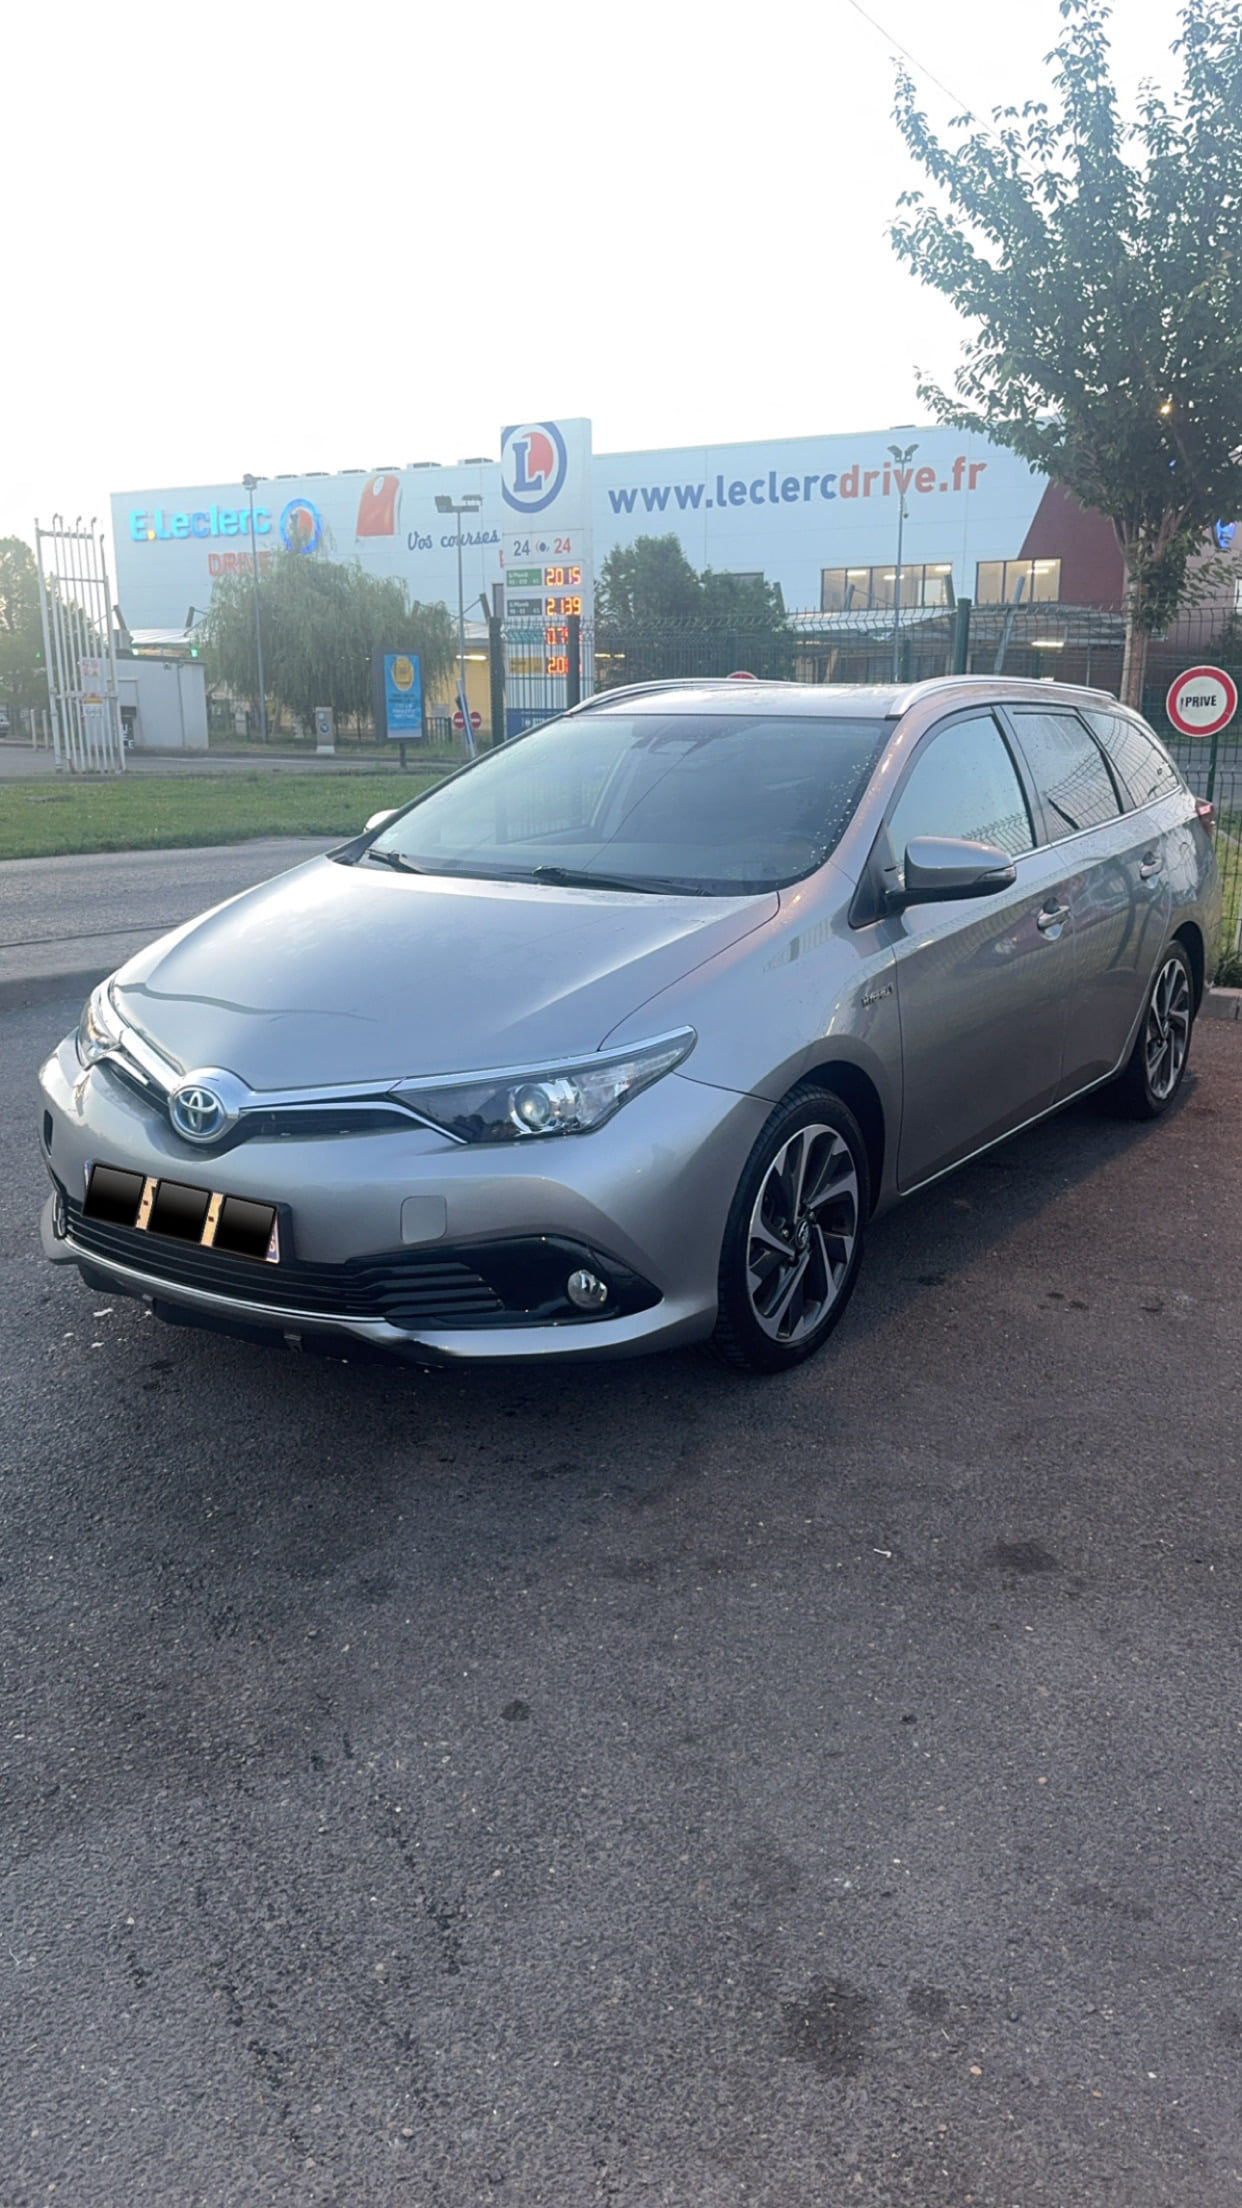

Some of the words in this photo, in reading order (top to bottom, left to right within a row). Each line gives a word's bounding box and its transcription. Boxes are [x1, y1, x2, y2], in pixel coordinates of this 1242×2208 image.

[608, 456, 987, 514] www.leclercdrive.fr
[130, 504, 271, 541] E.Leclerc
[407, 531, 432, 550] Vos
[441, 529, 500, 548] courses
[513, 540, 530, 556] 24
[554, 537, 571, 554] 24
[208, 551, 272, 577] DRIVE
[1185, 695, 1217, 708] PRIVE
